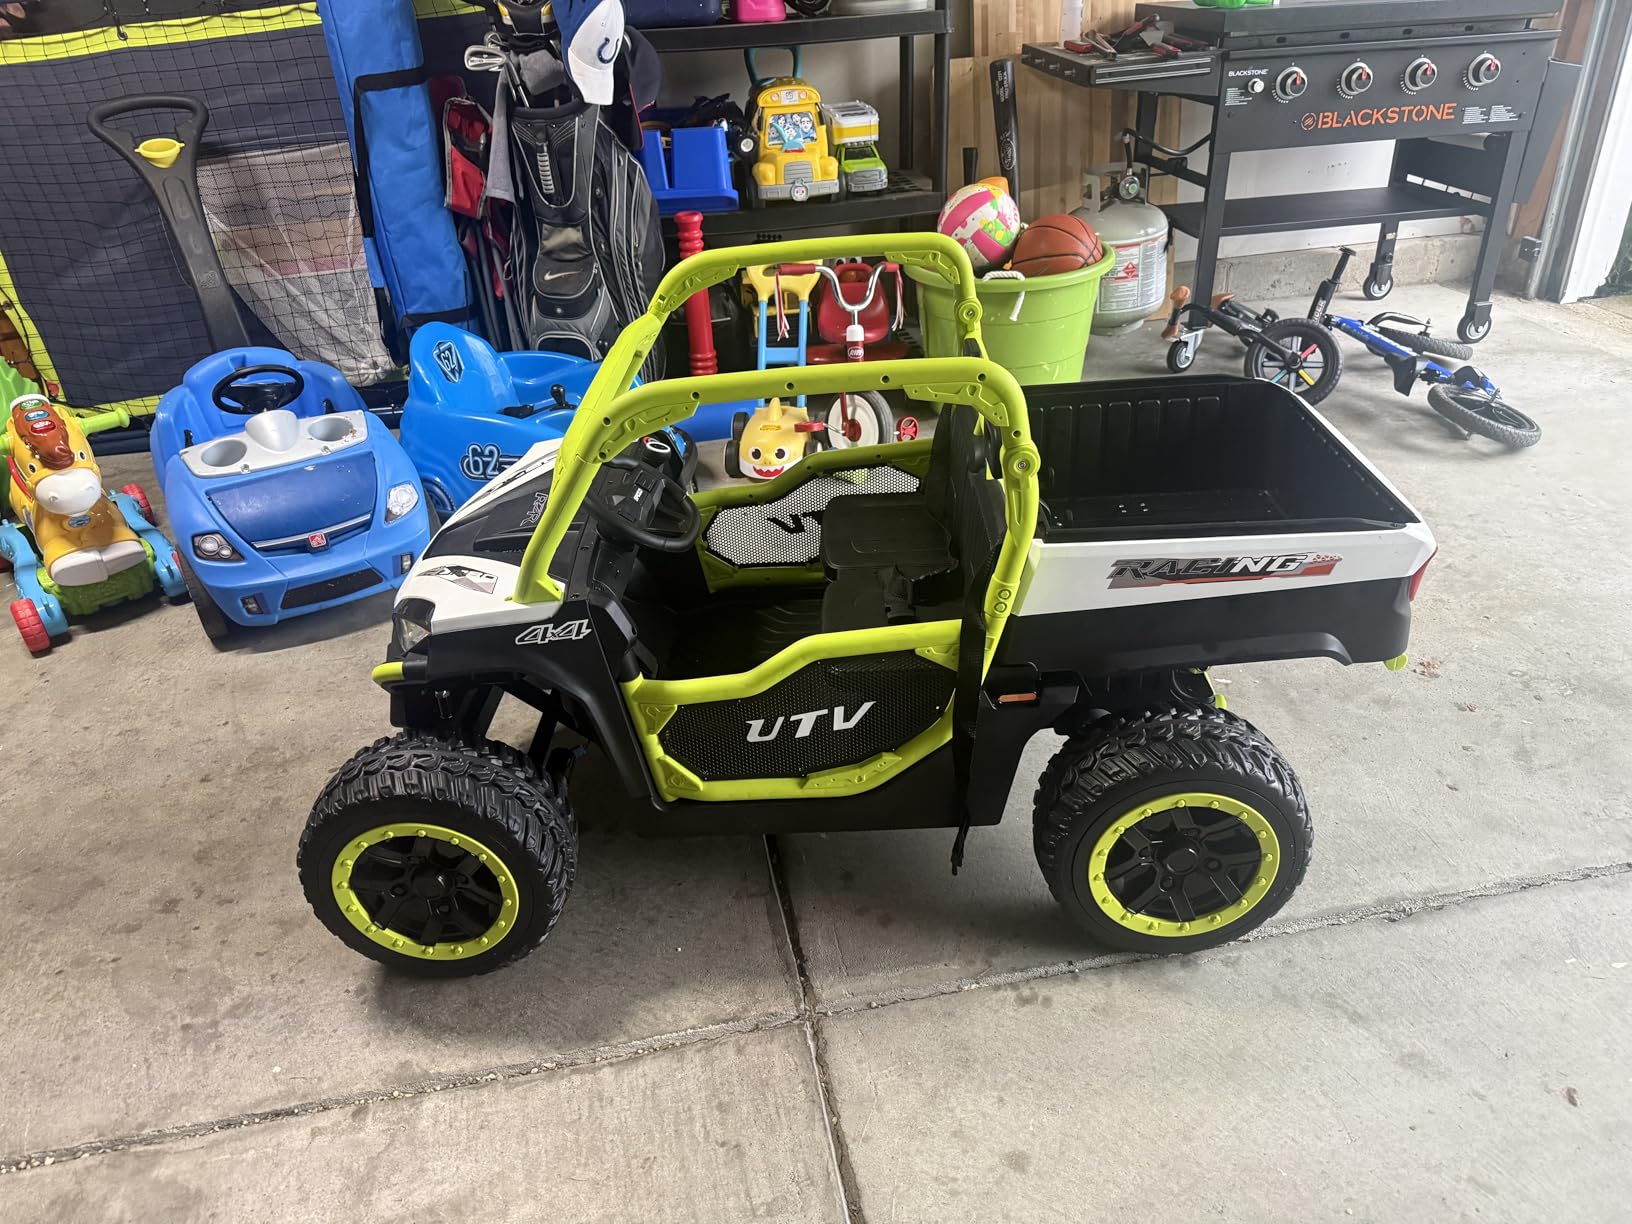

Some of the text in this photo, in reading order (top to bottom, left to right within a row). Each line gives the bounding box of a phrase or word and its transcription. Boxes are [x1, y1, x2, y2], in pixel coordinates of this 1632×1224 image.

[1228, 69, 1269, 77] BLACKSTONE
[1317, 102, 1457, 128] BLACKSTONE
[440, 350, 456, 370] 62
[468, 445, 499, 477] 62
[520, 491, 549, 527] RZR
[1106, 552, 1309, 580] RACING
[745, 701, 877, 743] UTV
